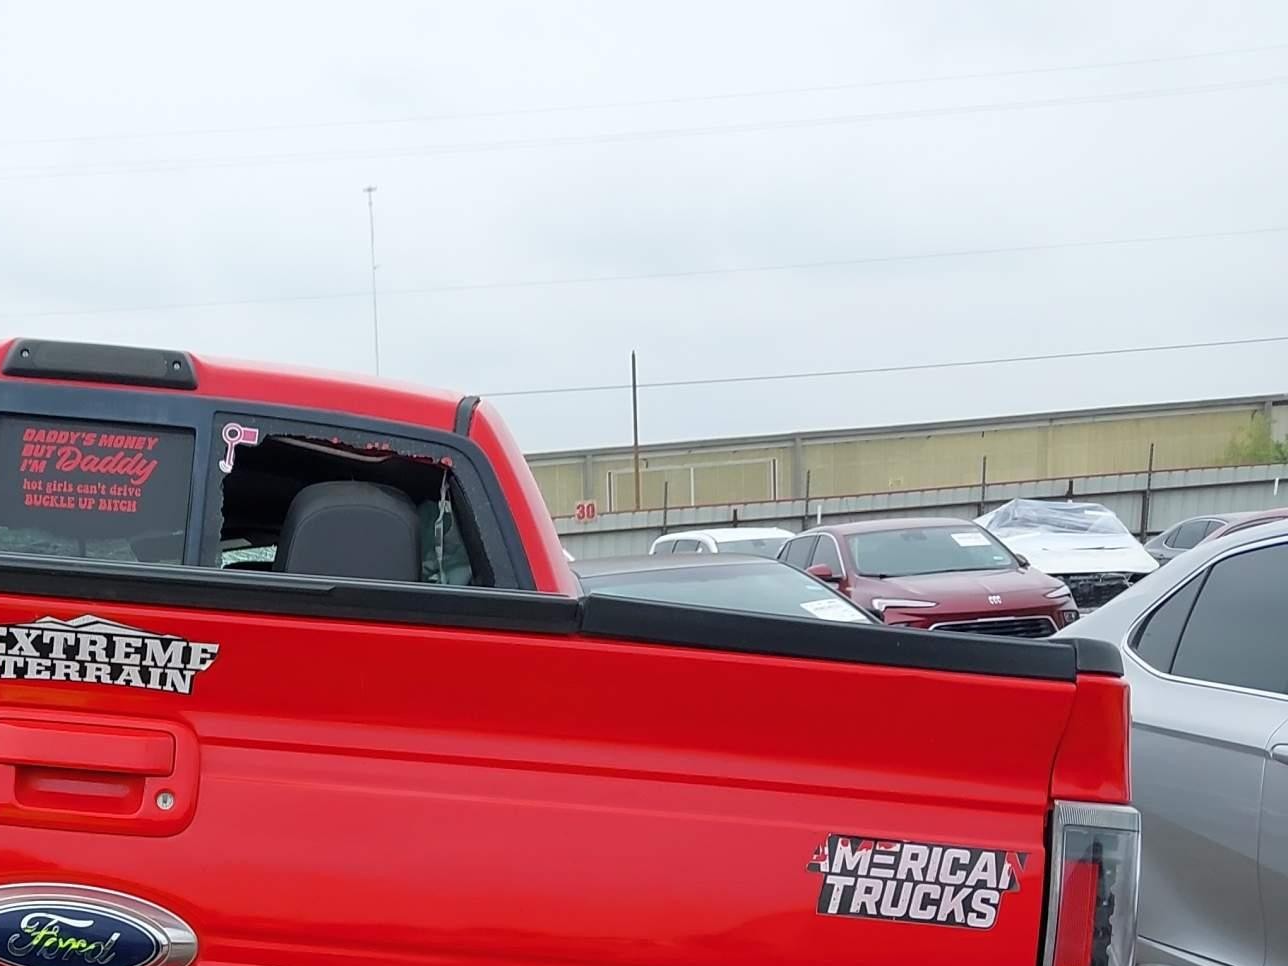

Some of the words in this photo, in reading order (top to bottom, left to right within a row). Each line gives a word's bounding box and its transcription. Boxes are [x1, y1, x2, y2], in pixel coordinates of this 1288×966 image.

[23, 429, 96, 446] DADDY'S
[98, 434, 159, 450] MONEY
[21, 444, 56, 458] BUT
[20, 459, 47, 473] I'M
[55, 446, 158, 485] Daddy
[23, 479, 43, 490] hot
[45, 480, 73, 494] girls
[76, 483, 107, 494] can't
[109, 485, 142, 497] drive
[24, 494, 75, 509] BUCKLE
[78, 497, 95, 510] UP
[98, 499, 137, 513] BITCH
[576, 503, 596, 521] 30
[824, 875, 1003, 929] TRUCKS
[7, 912, 121, 965] Ford
